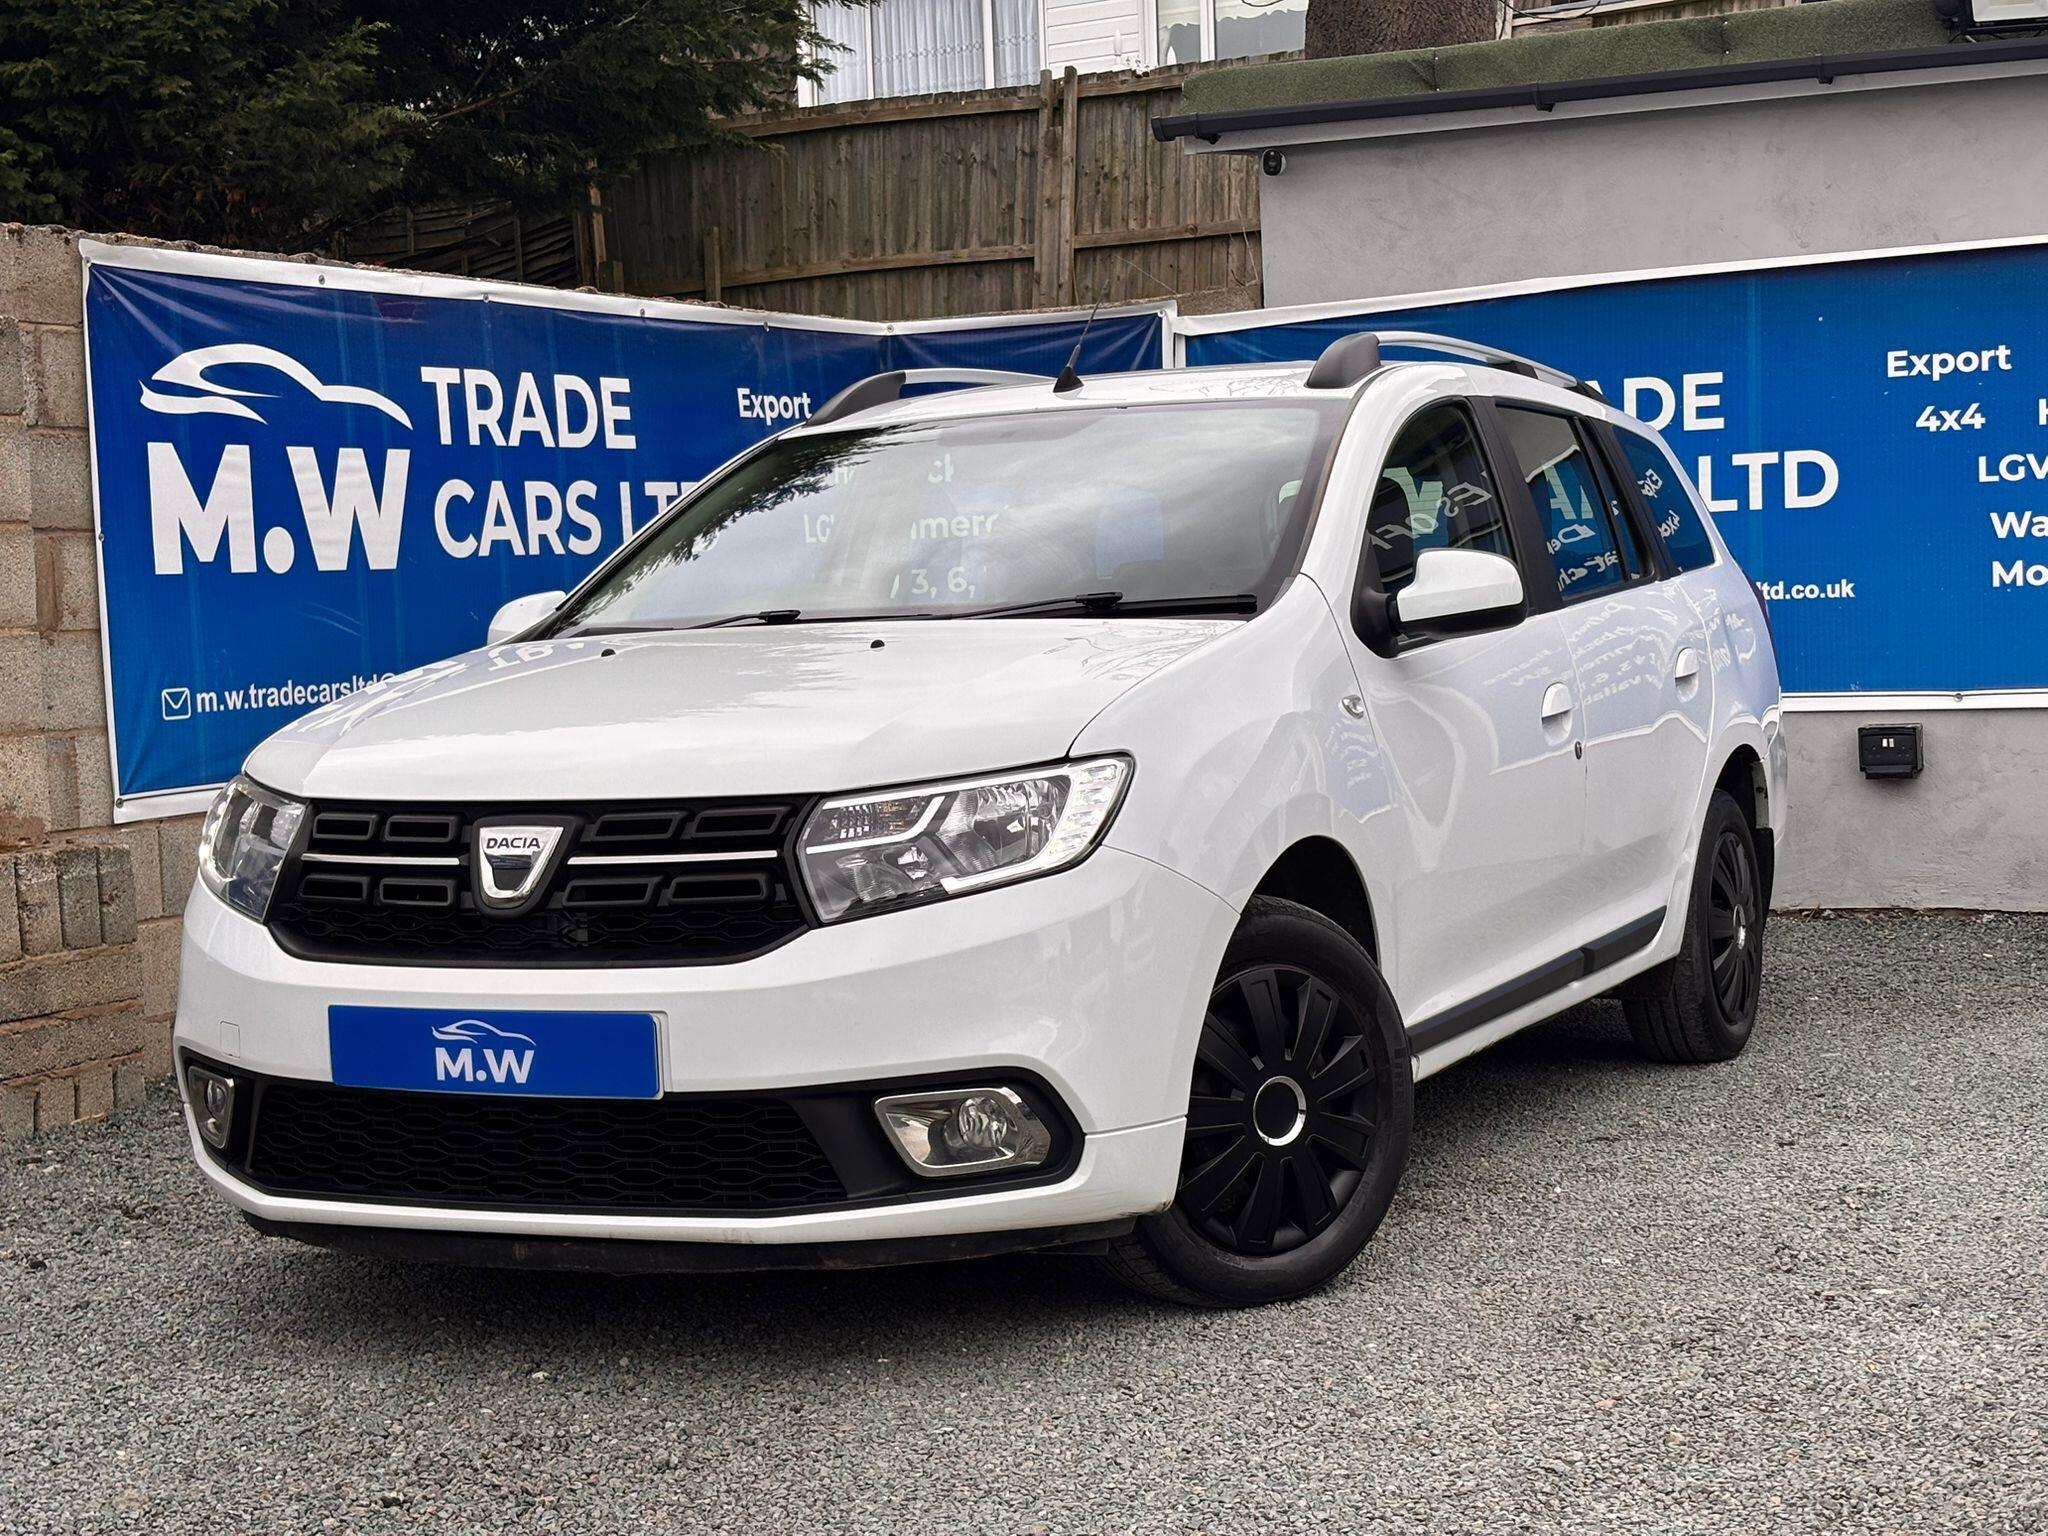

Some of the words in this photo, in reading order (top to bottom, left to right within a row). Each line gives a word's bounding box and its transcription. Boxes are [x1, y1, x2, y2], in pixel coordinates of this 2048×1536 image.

[1886, 344, 2012, 381] Export
[421, 366, 637, 450] TRADE
[737, 387, 812, 426] Export
[1585, 371, 1725, 431] DE
[1915, 402, 1986, 432] 4x4
[1698, 450, 1840, 513] LTD
[147, 442, 410, 575] M.W
[434, 479, 601, 559] CARS
[486, 837, 541, 849] DACIA
[434, 1046, 535, 1084] M.W
